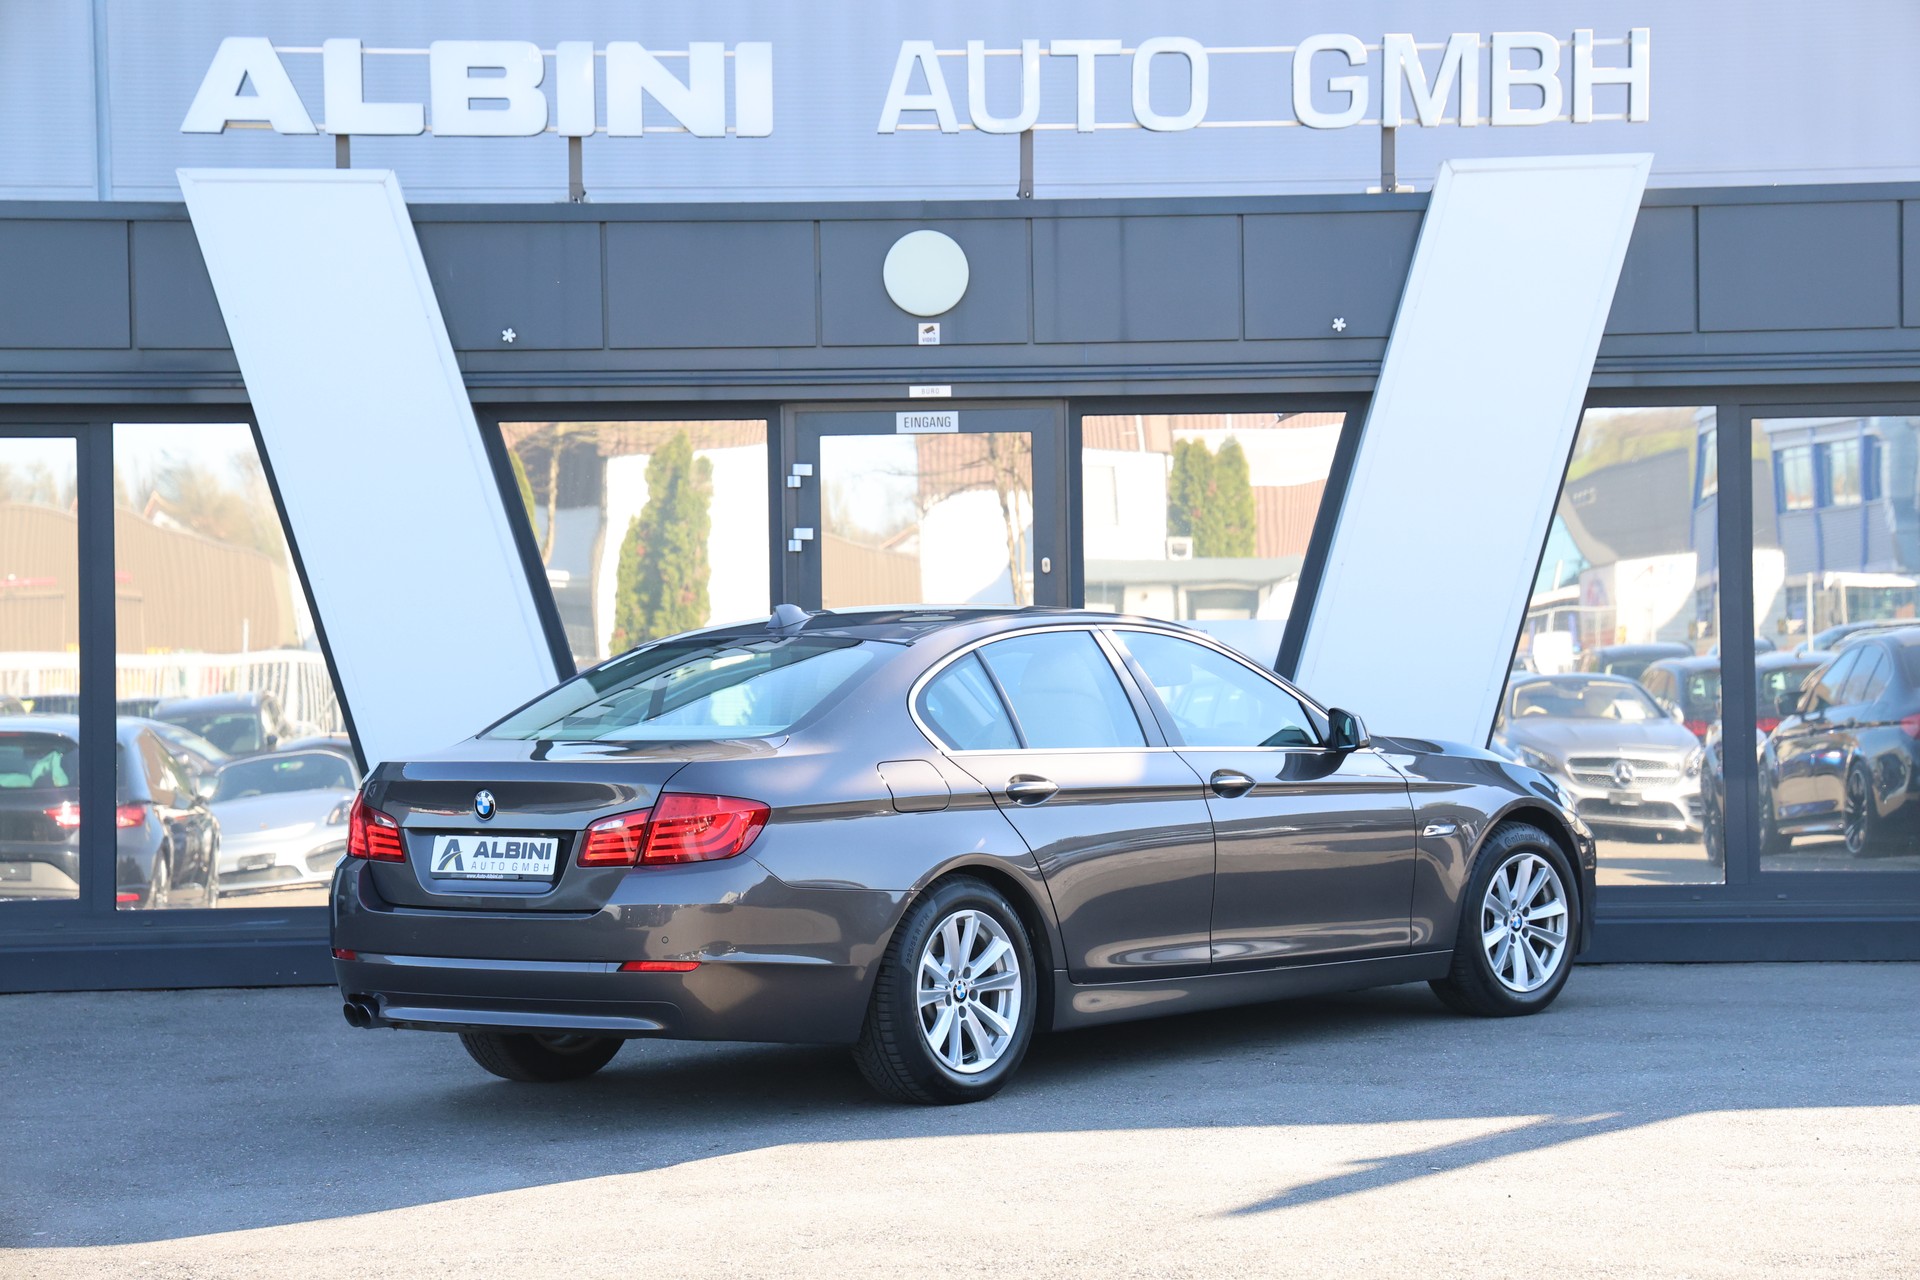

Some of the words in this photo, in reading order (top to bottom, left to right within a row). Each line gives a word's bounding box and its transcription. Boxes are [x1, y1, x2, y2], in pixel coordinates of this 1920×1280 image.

[180, 37, 773, 137] ALBINI
[877, 35, 1209, 134] AUTO
[1292, 28, 1651, 129] GMBH
[904, 416, 951, 428] EINGANG
[473, 841, 552, 860] ALBINI
[471, 861, 505, 871] AUTO
[512, 862, 550, 872] GMBH
